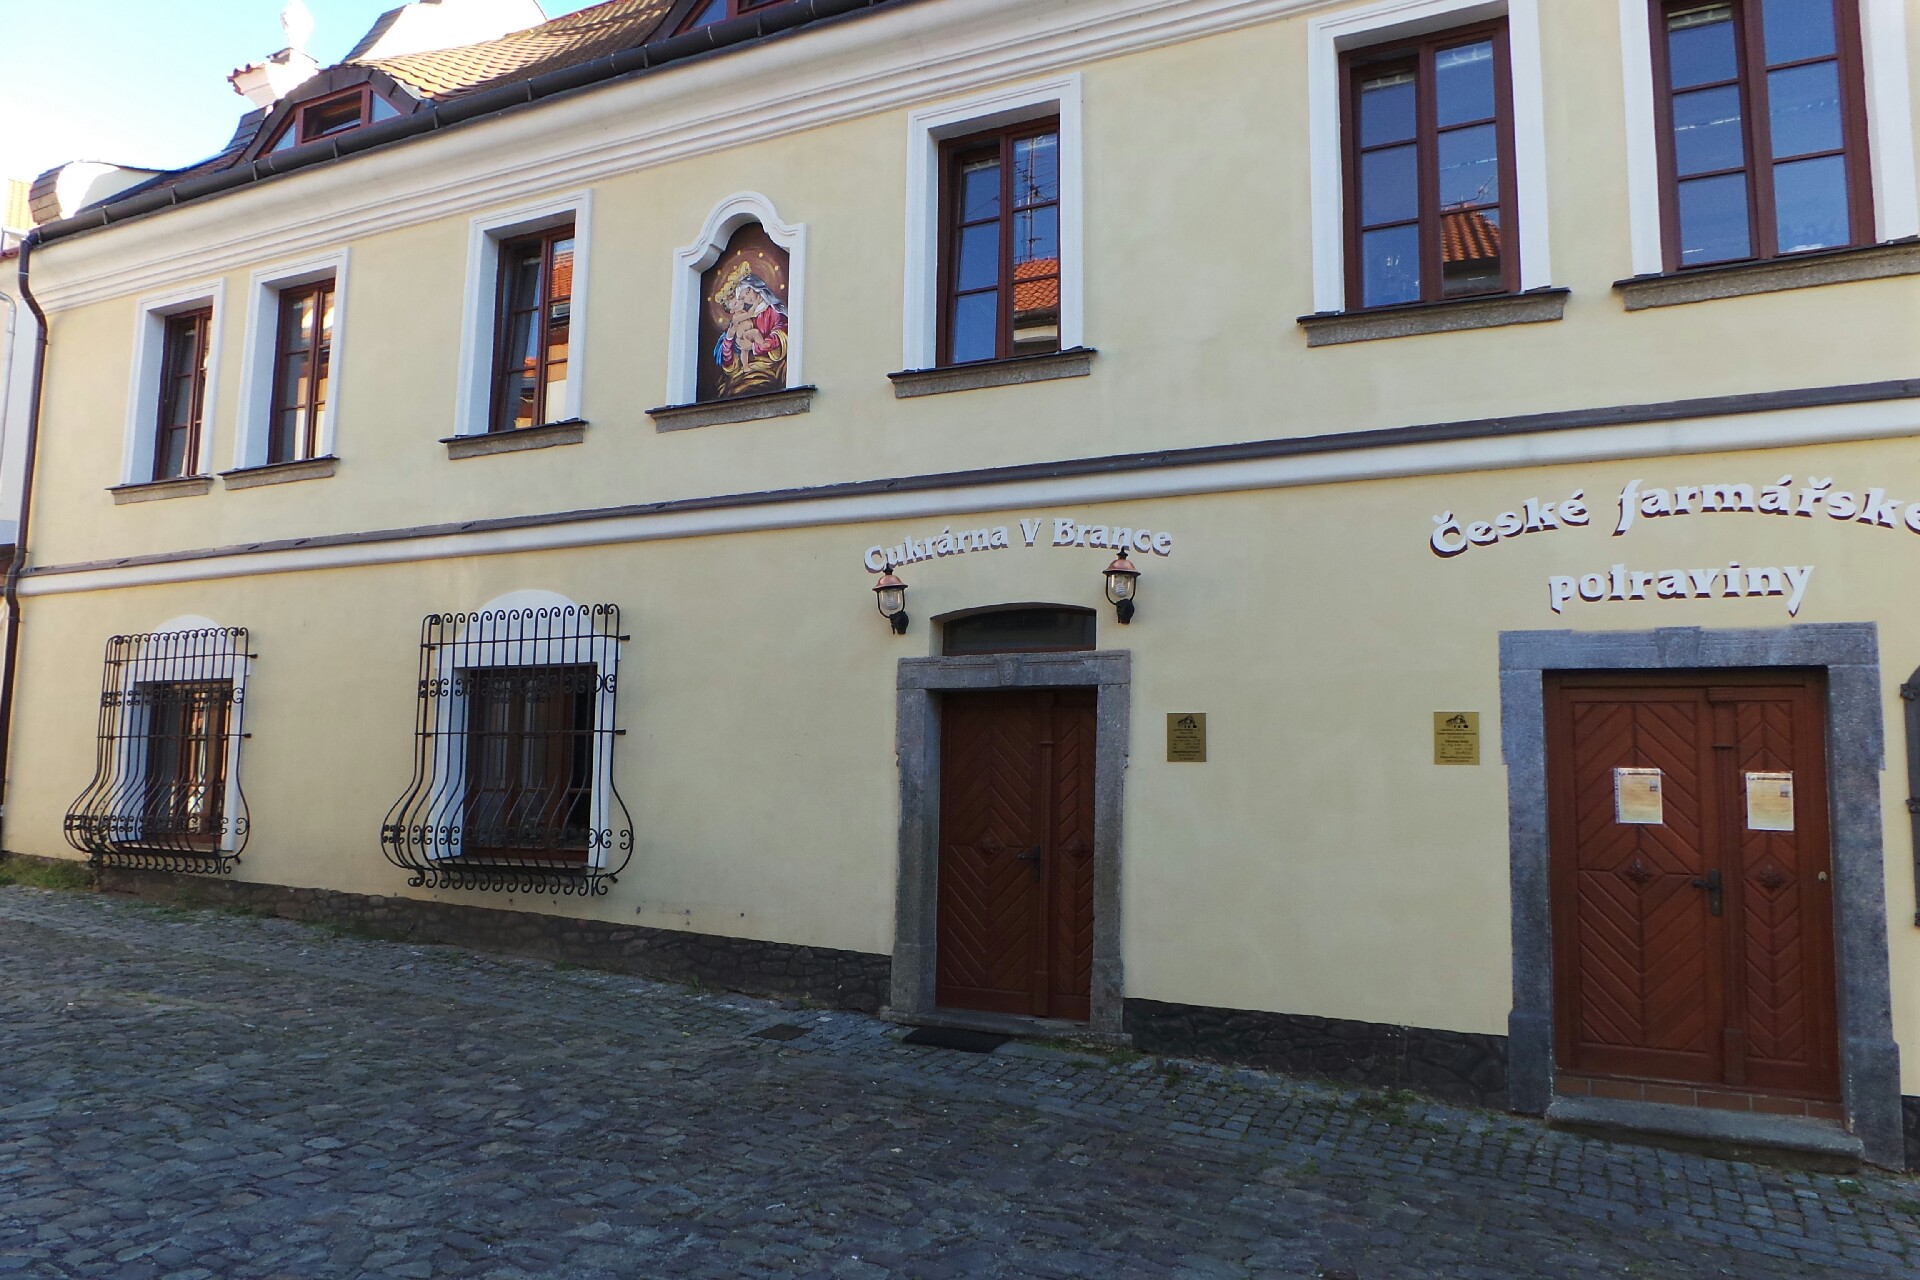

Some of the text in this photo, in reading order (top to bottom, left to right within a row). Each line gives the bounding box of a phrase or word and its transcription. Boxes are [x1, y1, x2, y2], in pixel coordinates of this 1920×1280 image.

[864, 517, 1172, 574] Cukrárna V Brance
[1430, 488, 1590, 558] České
